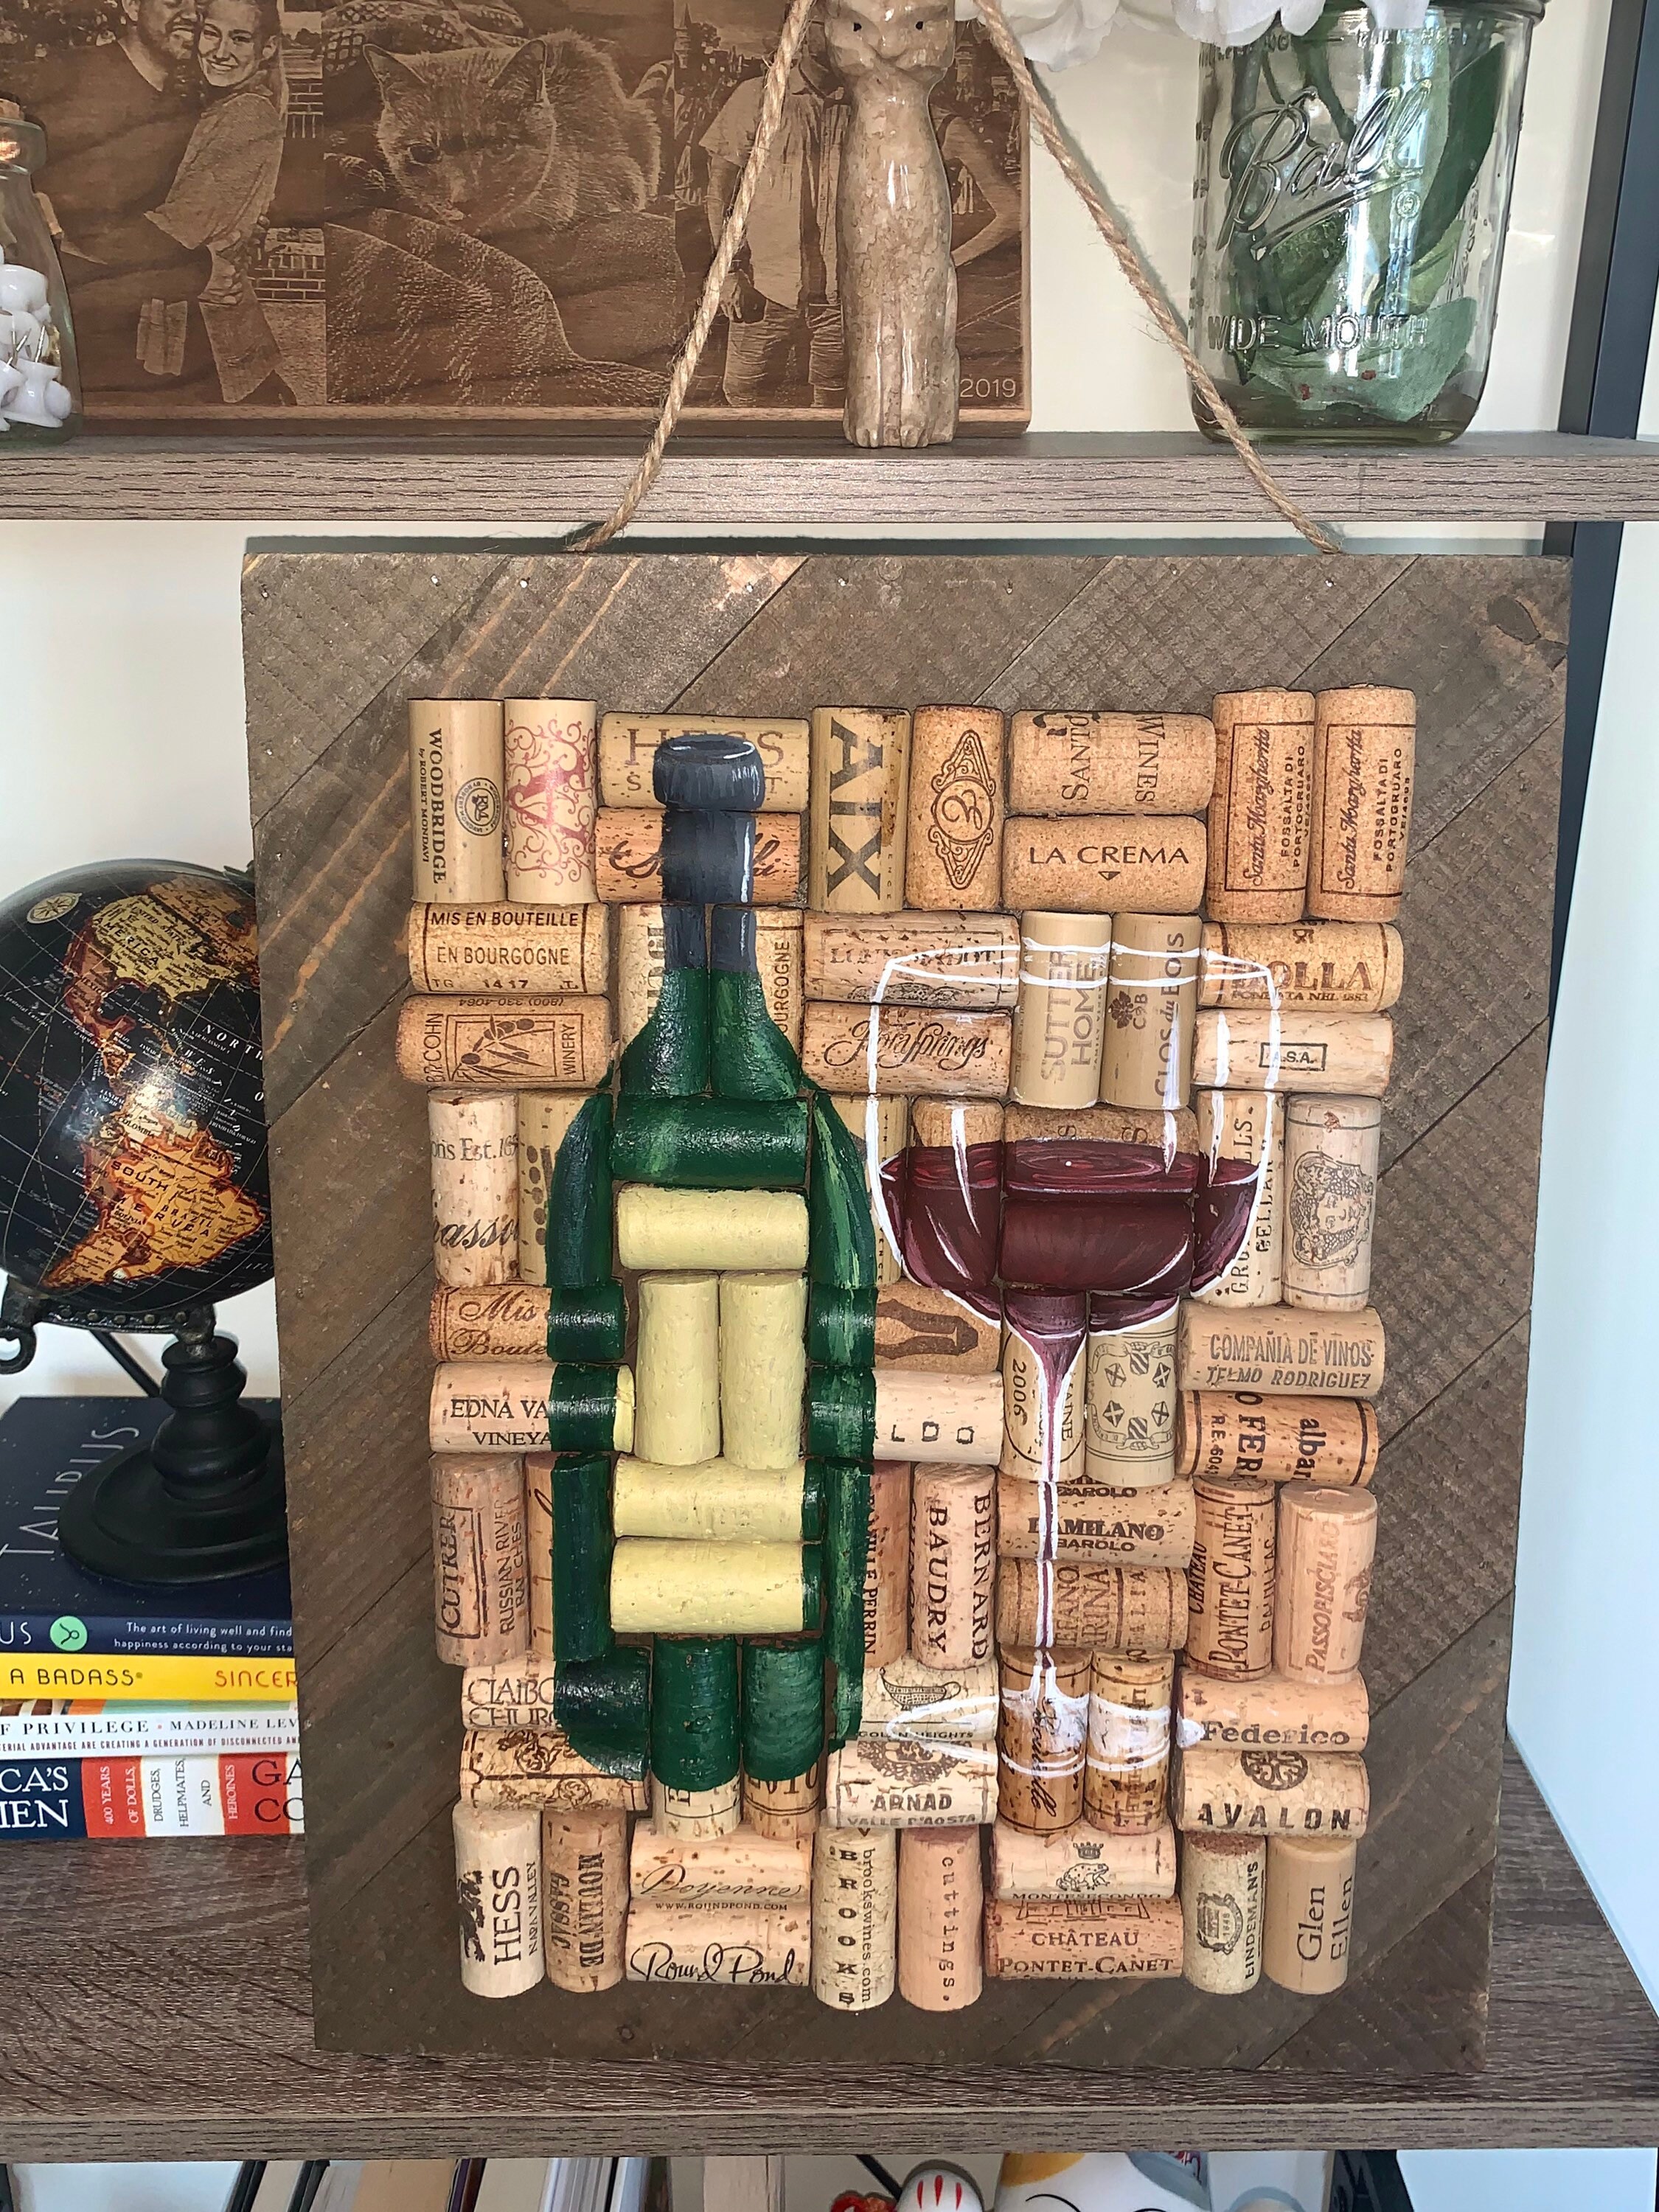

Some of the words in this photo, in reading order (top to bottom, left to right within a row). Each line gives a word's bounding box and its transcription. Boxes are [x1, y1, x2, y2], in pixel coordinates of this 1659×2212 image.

[1215, 78, 1432, 252] Ball
[1208, 315, 1281, 351] WIDE
[1301, 315, 1430, 352] MOUTH
[959, 378, 1017, 399] 2019
[1061, 714, 1091, 801] SANTO
[1135, 715, 1166, 803] WINES
[1284, 757, 1293, 773] DI
[420, 760, 428, 804] ROBERT
[428, 727, 447, 885] WOODBRIDGE
[1280, 779, 1293, 858] FOSSALTA
[1293, 745, 1305, 868] PORTOGRUARO
[1373, 776, 1387, 861] FOSSALTA
[1380, 758, 1389, 773] DI
[1385, 748, 1402, 872] PORTOGRUARO
[420, 807, 430, 863] MONDAVI
[1029, 847, 1067, 865] LA
[1077, 846, 1189, 865] CREMA
[1243, 833, 1265, 887] Santa
[1337, 837, 1357, 889] Santa
[431, 911, 461, 926] MIS
[466, 911, 487, 926] EN
[491, 911, 579, 927] BOUTEILLE
[437, 947, 457, 964] EN
[464, 947, 570, 965] BOURGOGNE
[1160, 932, 1185, 996] BOIS
[459, 997, 524, 1007] 330-4064
[529, 998, 564, 1007] (800)
[1040, 950, 1074, 1082] SUTTER
[1071, 959, 1095, 1066] HOME
[1160, 999, 1175, 1023] du
[423, 1013, 444, 1057] COHN
[560, 1023, 576, 1075] WINERY
[459, 1137, 496, 1161] Est.
[110, 1160, 169, 1192] SOUTH
[113, 1211, 144, 1225] BOLIVIA
[161, 1204, 213, 1228] BRAZIL
[459, 1290, 537, 1322] Mis
[1298, 1338, 1318, 1365] DE
[1324, 1339, 1373, 1368] VINOS
[1012, 1359, 1028, 1417] 2006
[1206, 1365, 1263, 1384] TELMO
[1270, 1369, 1371, 1390] RODRIGUEZ
[450, 1398, 515, 1419] EDNA
[927, 1506, 950, 1654] BAUDRY
[972, 1489, 992, 1660] BERNARD
[1188, 1540, 1208, 1615] CHATEAU
[496, 1555, 515, 1635] RUSSIAN
[114, 1638, 170, 1650] happiness
[172, 1641, 229, 1653] according
[230, 1643, 243, 1651] to
[246, 1644, 272, 1654] your
[125, 1621, 147, 1632] The
[150, 1624, 167, 1634] art
[170, 1623, 184, 1634] of
[186, 1624, 218, 1638] living
[220, 1625, 243, 1636] well
[245, 1627, 267, 1637] and
[269, 1627, 293, 1637] find
[9, 1668, 25, 1686] A
[23, 1719, 150, 1736] PRIVILEGE
[30, 1741, 77, 1751] ADVANTAGE
[81, 1740, 97, 1750] ARE
[100, 1739, 142, 1749] CREATING
[145, 1739, 150, 1748] A
[153, 1739, 204, 1748] GENERATION
[207, 1739, 217, 1747] OF
[220, 1736, 282, 1747] DISCONNECTED
[169, 1718, 260, 1731] MADELINE
[914, 1731, 974, 1739] HEIGHTS
[1199, 1719, 1351, 1745] Federico
[100, 1765, 112, 1806] YEARS
[201, 1779, 212, 1807] AND
[224, 1764, 239, 1820] HEROINES
[871, 1792, 953, 1812] ARNAD
[103, 1807, 114, 1826] 400
[128, 1809, 140, 1824] OF
[846, 1816, 902, 1826] VALLE
[1197, 1802, 1352, 1831] AVALON
[526, 1860, 538, 1916] VALLEY
[577, 1851, 605, 1935] MOULIN
[641, 1863, 802, 1901] Doyenne
[492, 1865, 522, 1966] HESS
[655, 1902, 787, 1911] WWW.ROUNDPOND.COM
[860, 1848, 876, 2003] brookswines.com
[1245, 1861, 1259, 1980] LINDEMAN'S
[1296, 1885, 1326, 1962] Glen
[1330, 1876, 1353, 1961] Ellen
[528, 1917, 538, 1956] NAPA
[579, 1938, 605, 1968] DE
[630, 1941, 724, 1983] Round
[713, 1946, 799, 1985] Pond
